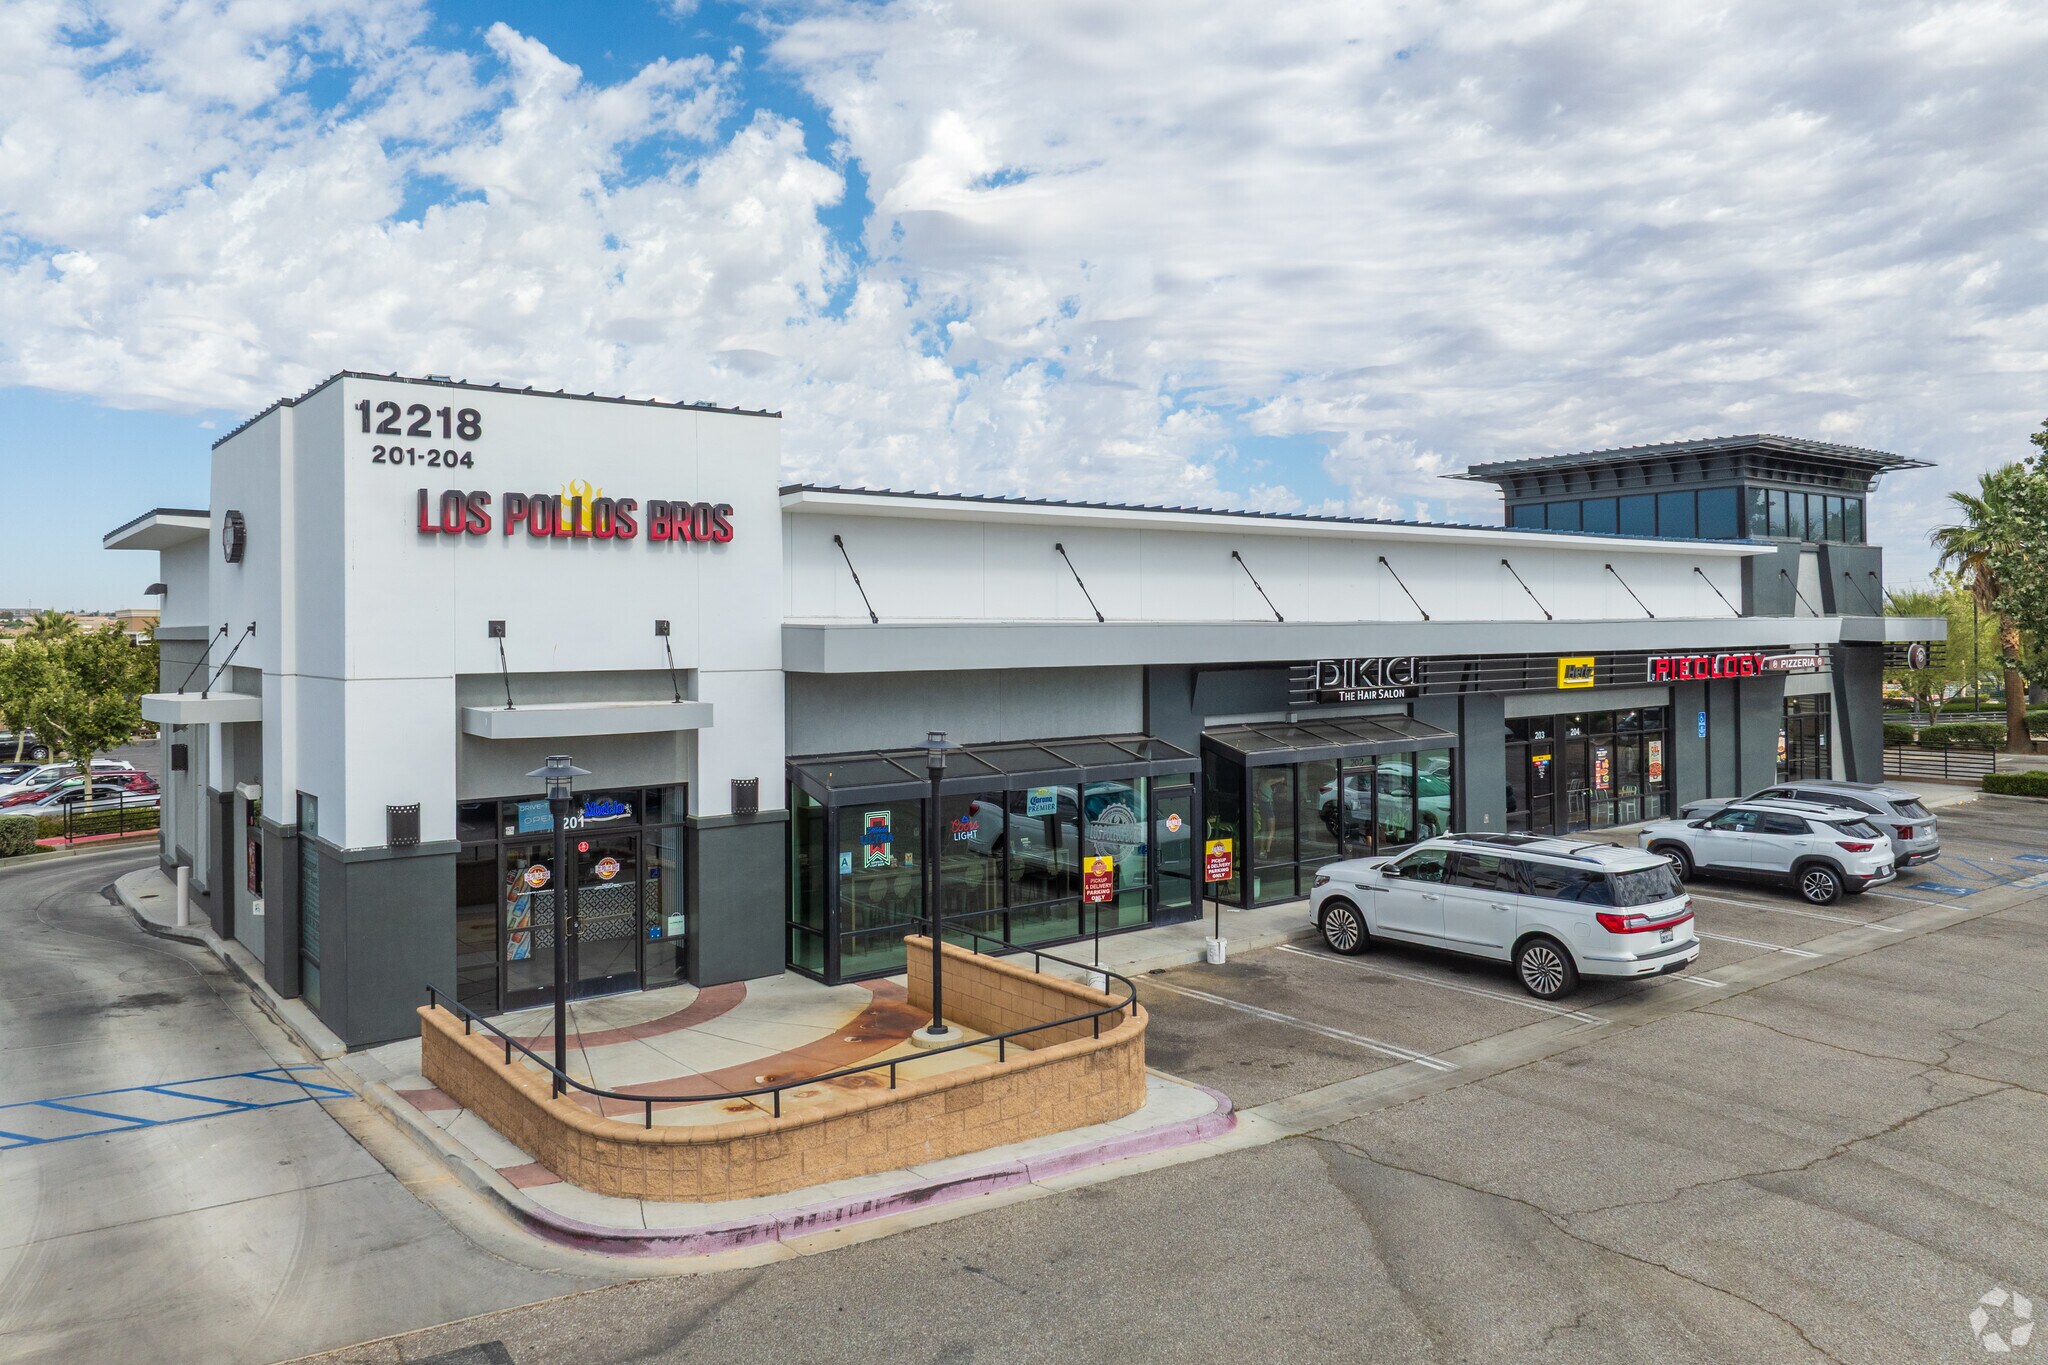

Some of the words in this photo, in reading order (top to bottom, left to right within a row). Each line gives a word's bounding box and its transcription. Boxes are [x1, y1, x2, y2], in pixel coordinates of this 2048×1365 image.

[355, 399, 482, 441] 12218
[371, 445, 475, 469] 201-204
[417, 488, 492, 535] LOS
[503, 492, 639, 539] POLLOS
[647, 499, 735, 543] BROS
[1647, 654, 1766, 682] PIEOLOGY
[1780, 658, 1815, 669] PIZZERIA
[1565, 664, 1594, 678] Hertz
[1534, 731, 1545, 740] 203
[1570, 727, 1580, 736] 204
[1028, 803, 1056, 812] PREMIER
[563, 816, 585, 830] 201
[951, 819, 979, 832] Coors
[953, 830, 978, 841] LIGHT
[841, 858, 848, 866] A
[1090, 882, 1112, 890] DELIVERY
[1086, 888, 1110, 896] PARKING
